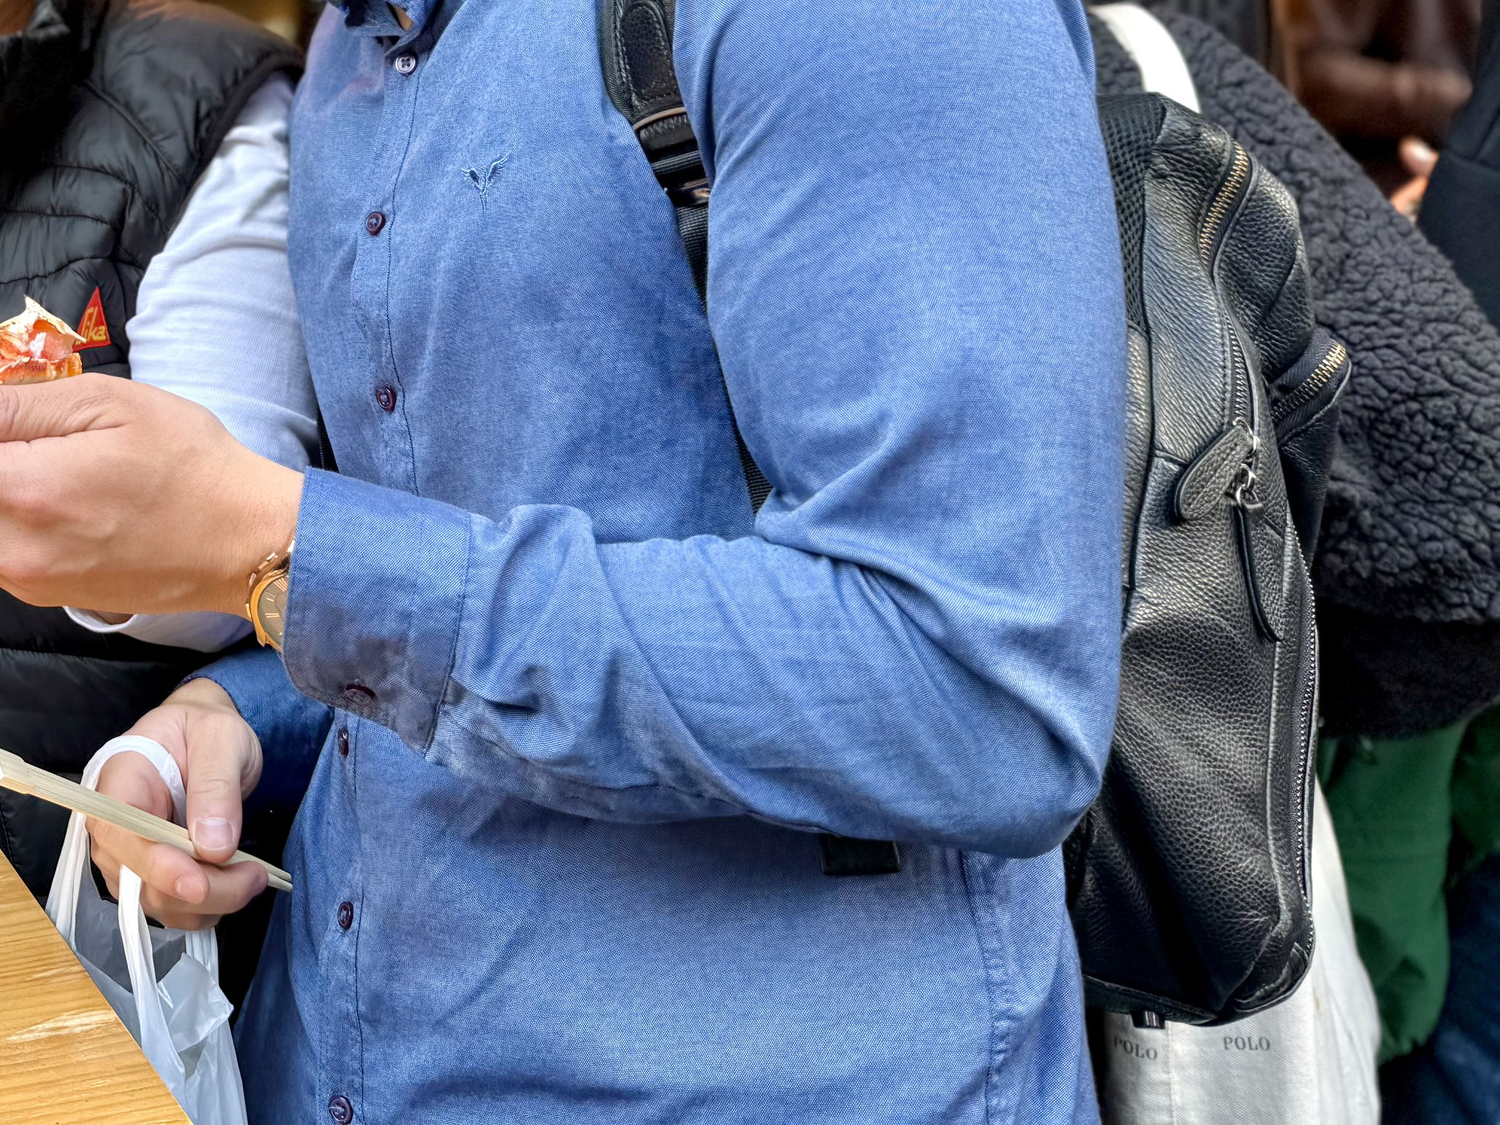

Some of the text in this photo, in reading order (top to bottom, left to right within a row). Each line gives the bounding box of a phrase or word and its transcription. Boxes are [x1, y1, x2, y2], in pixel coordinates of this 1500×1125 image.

[75, 306, 107, 345] Sika
[1113, 1035, 1158, 1061] POLO
[1222, 1035, 1271, 1052] POLO
